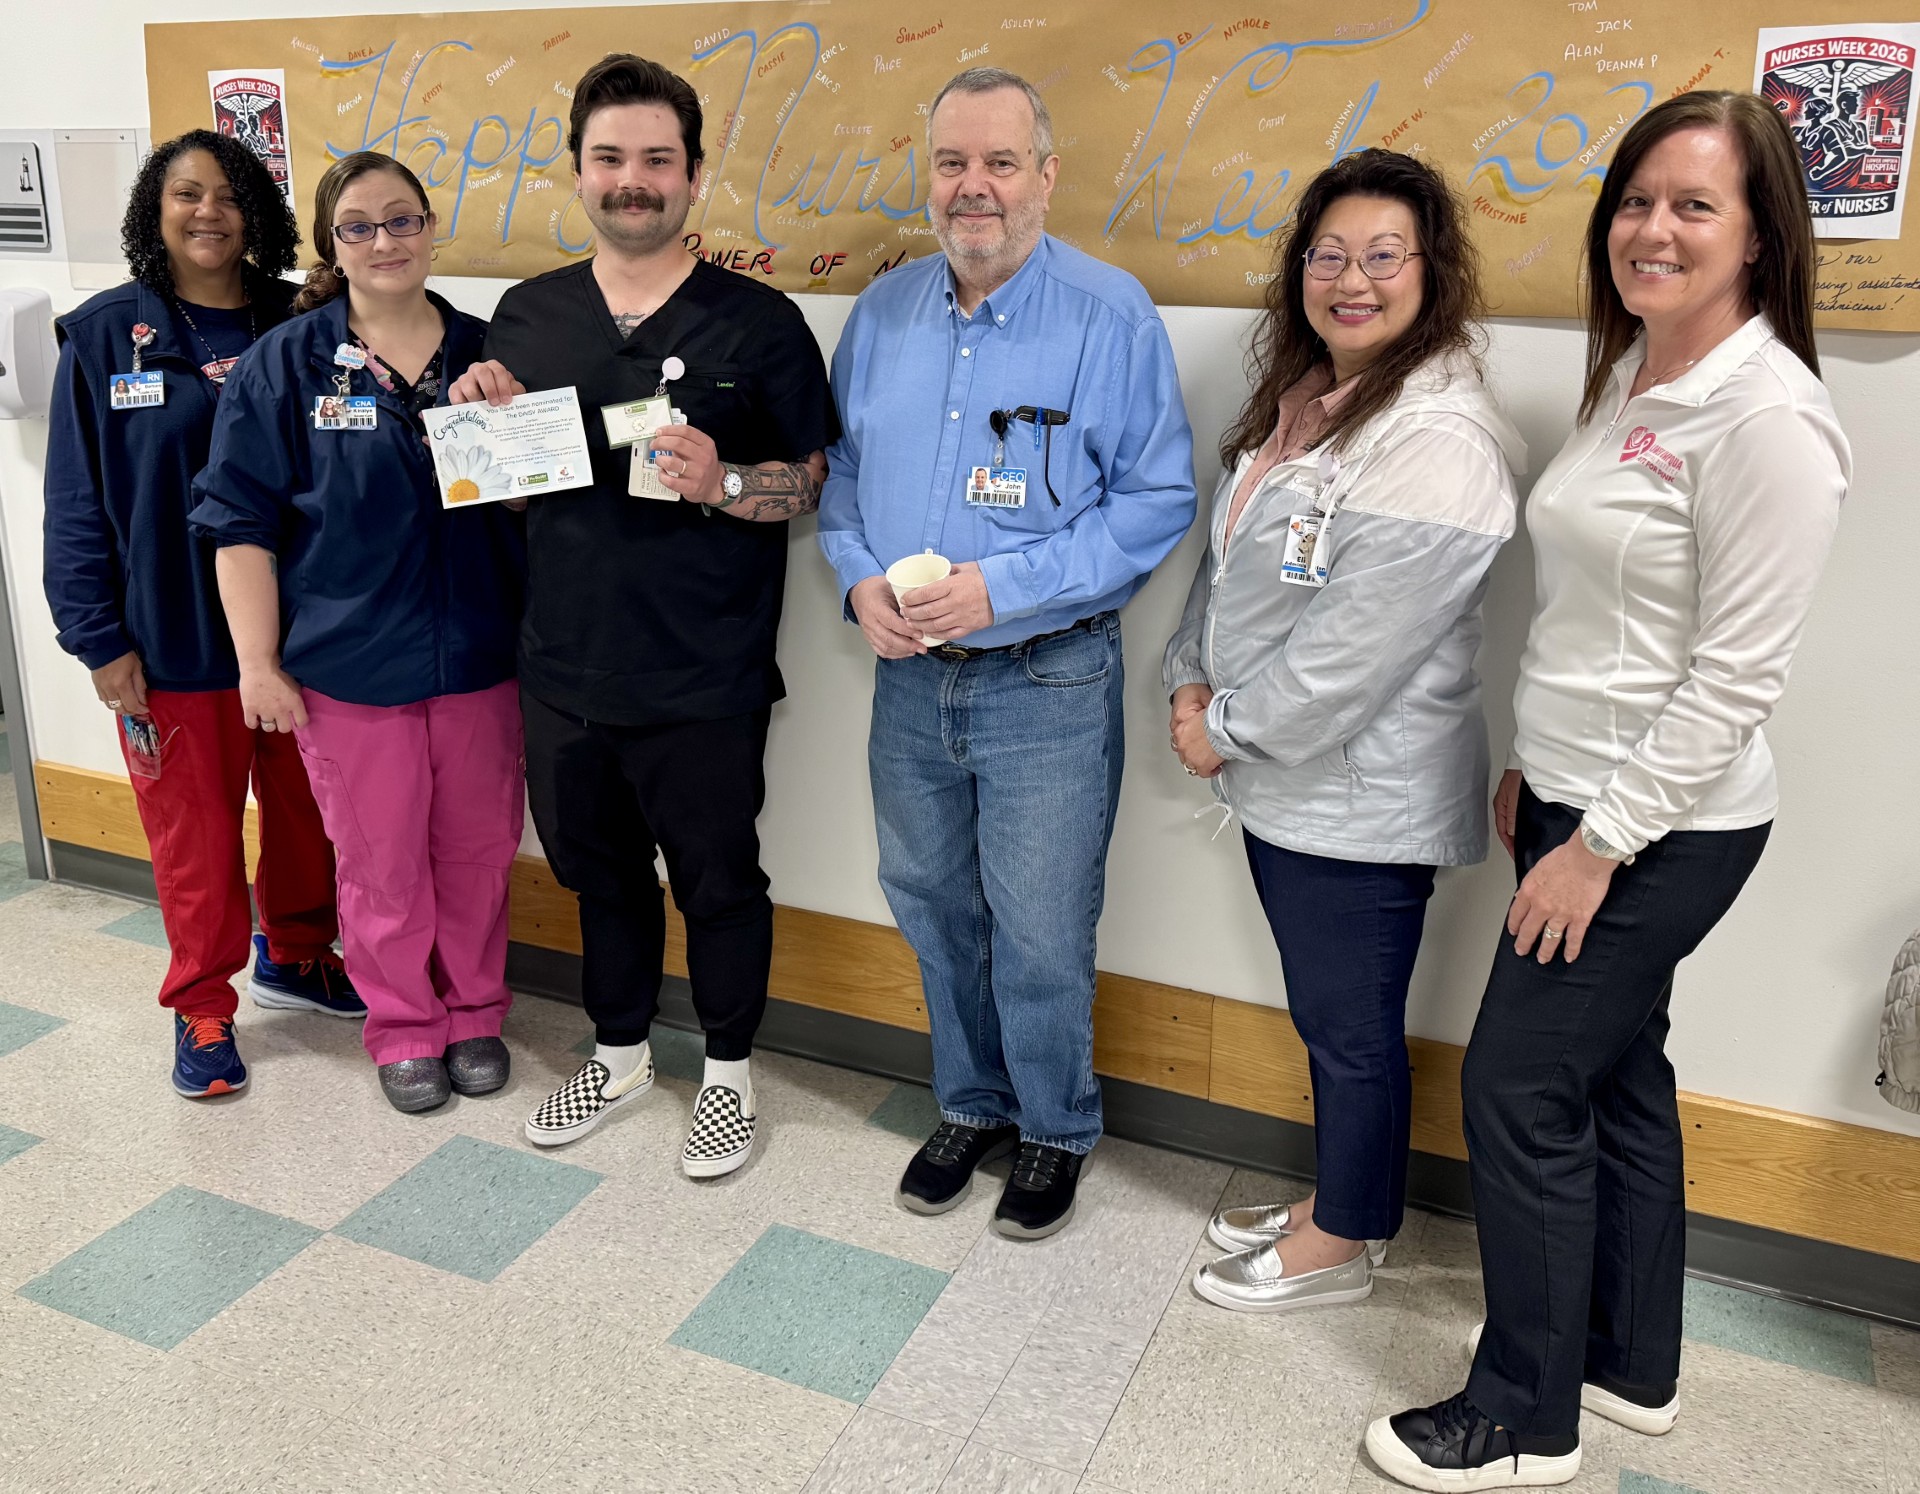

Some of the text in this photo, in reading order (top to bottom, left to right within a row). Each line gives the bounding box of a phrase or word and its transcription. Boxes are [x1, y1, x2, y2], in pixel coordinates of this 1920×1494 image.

[1568, 0, 1598, 14] TOM
[896, 19, 944, 44] SHANNON
[1223, 18, 1271, 41] NICHOLE
[1595, 19, 1633, 34] JACK
[694, 28, 731, 51] DAVID
[1177, 31, 1193, 45] ED
[348, 47, 374, 61] DAVE A
[820, 42, 848, 64] ERIC L.
[956, 42, 990, 63] JANINE
[1423, 31, 1474, 89] MAKENZIE
[1564, 43, 1604, 61] ALAN
[1769, 40, 1909, 68] NURSES WEEK 2026
[400, 50, 423, 87] PATRICK
[486, 55, 517, 86] SERENIA
[757, 51, 786, 78] CASSIE
[873, 54, 902, 75] PAIGE
[1596, 54, 1658, 73] DEANNA P
[214, 79, 278, 98] NURSES WEEK 2026
[815, 69, 833, 89] ERIC
[1101, 64, 1130, 93] JARVIE
[422, 82, 443, 105] KRISTY
[1185, 75, 1219, 128] MARCELLA
[775, 88, 798, 126] NATHAN
[716, 110, 737, 150] ELLIE
[730, 115, 746, 152] JESSICA
[834, 123, 873, 136] CELESTE
[1258, 113, 1286, 132] CATHY
[1325, 100, 1355, 151] SHAYLYNN
[1381, 119, 1410, 148] DAVE
[1472, 114, 1517, 152] KRYSTAL
[890, 134, 912, 152] JULIA
[1132, 129, 1145, 150] MAY
[1578, 126, 1617, 166] DEANNA
[768, 145, 784, 172] SARA
[1211, 150, 1253, 177] CHERYL
[1865, 163, 1897, 172] HOSPITAL
[467, 170, 504, 192] ADRIENNE
[525, 179, 553, 194] ERIN
[698, 170, 713, 201] BRIAN
[864, 167, 881, 200] AUGUST
[722, 180, 743, 206] MEGAN
[1472, 196, 1528, 224] KRISTINE
[1821, 201, 1834, 214] of
[1834, 196, 1889, 215] NURSES
[714, 227, 743, 239] CARLI
[1104, 199, 1145, 249] JENNIFER
[1182, 218, 1202, 235] AMY
[866, 242, 887, 261] TINA
[1845, 254, 1883, 265] our
[810, 253, 848, 276] OF
[147, 373, 161, 382] RN
[515, 402, 530, 410] been
[531, 397, 563, 407] nominated
[518, 409, 537, 418] DAISY
[537, 405, 560, 415] AWARD
[1000, 471, 1025, 482] CEO
[1646, 461, 1675, 483] FOR PINK
